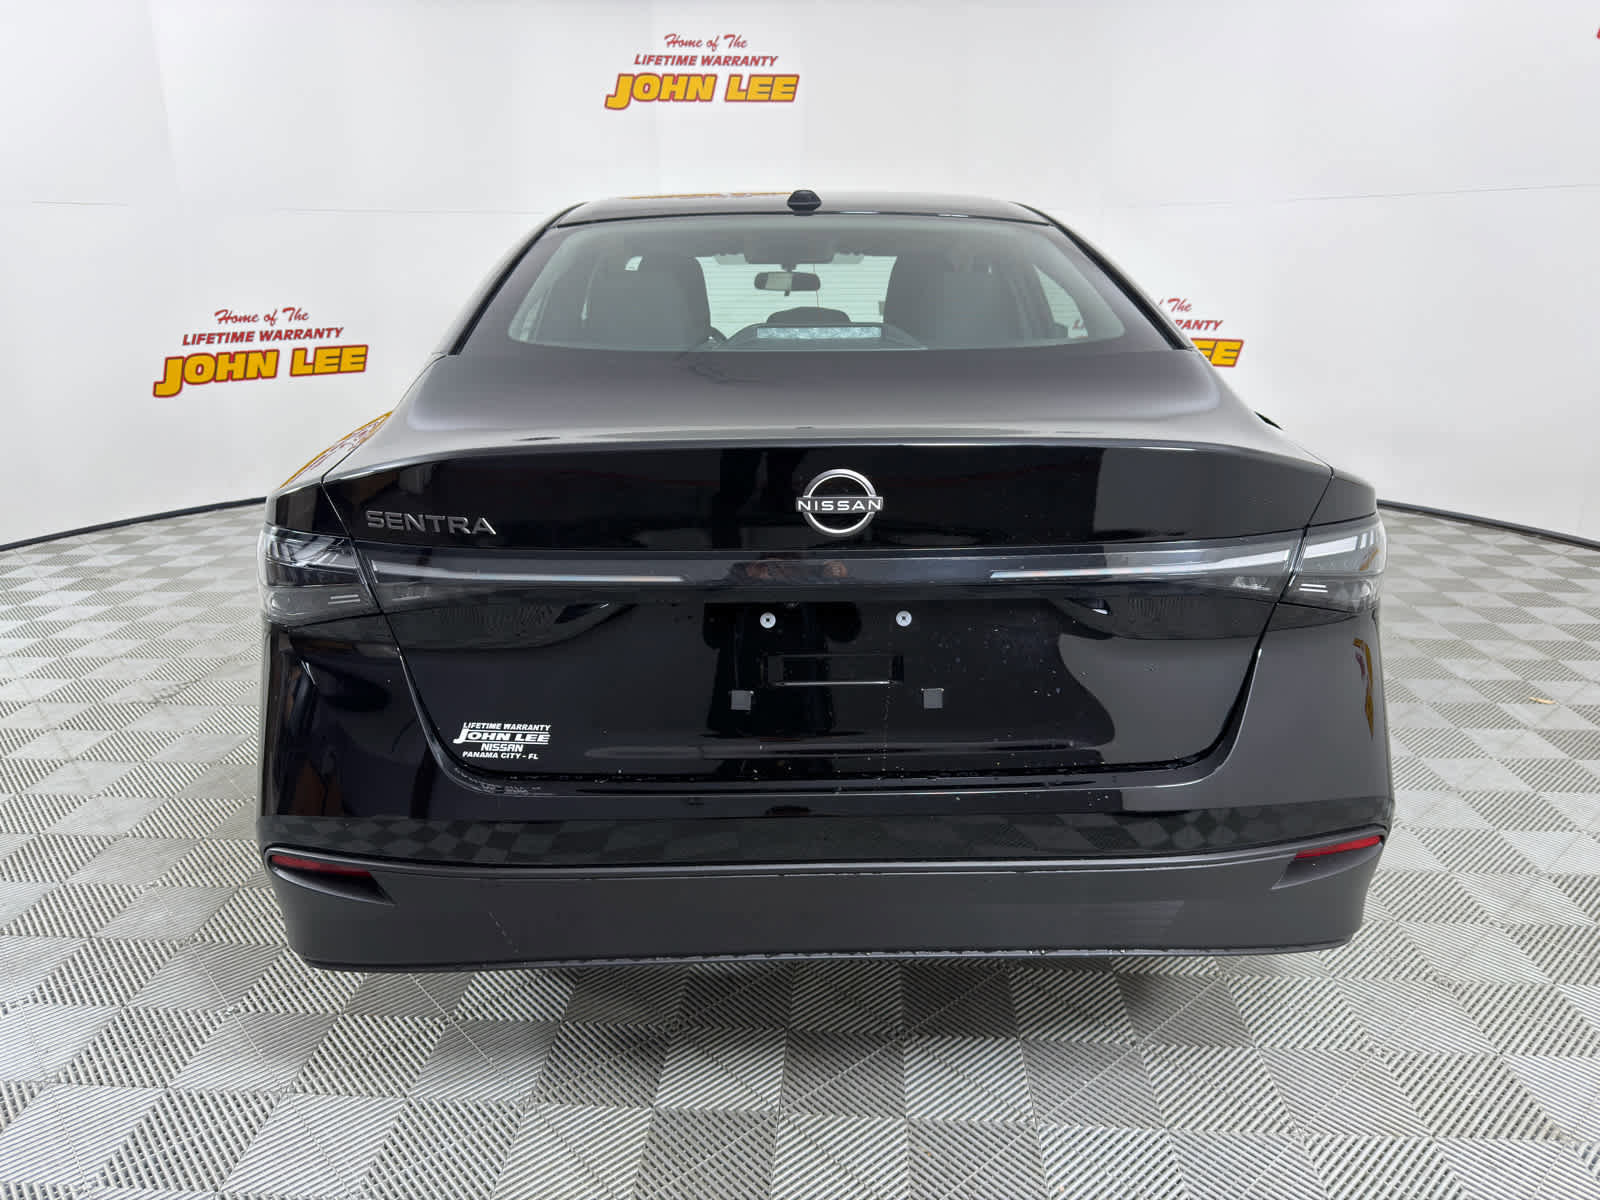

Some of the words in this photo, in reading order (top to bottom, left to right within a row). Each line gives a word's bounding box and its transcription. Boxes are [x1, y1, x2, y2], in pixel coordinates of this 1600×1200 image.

[664, 33, 703, 48] Home
[706, 35, 719, 51] of
[723, 34, 747, 48] The
[634, 54, 697, 66] LIFETIME
[701, 55, 778, 66] WARRANTY
[605, 73, 717, 110] JOHN
[724, 74, 799, 102] LEE
[1167, 298, 1192, 312] The
[214, 309, 259, 324] Home
[263, 309, 277, 325] of
[282, 307, 309, 321] The
[182, 331, 254, 345] LIFETIME
[259, 327, 344, 342] WARRANTY
[153, 349, 280, 397] JOHN
[290, 344, 368, 376] LEE
[797, 499, 881, 511] NISSAN
[366, 510, 497, 535] SENTRA
[463, 722, 502, 730] LIFETIME
[503, 723, 551, 731] WARRANTY
[453, 728, 511, 744] JOHN
[514, 733, 551, 743] LEE
[462, 751, 499, 759] PANAMA
[481, 743, 524, 752] NISSAN
